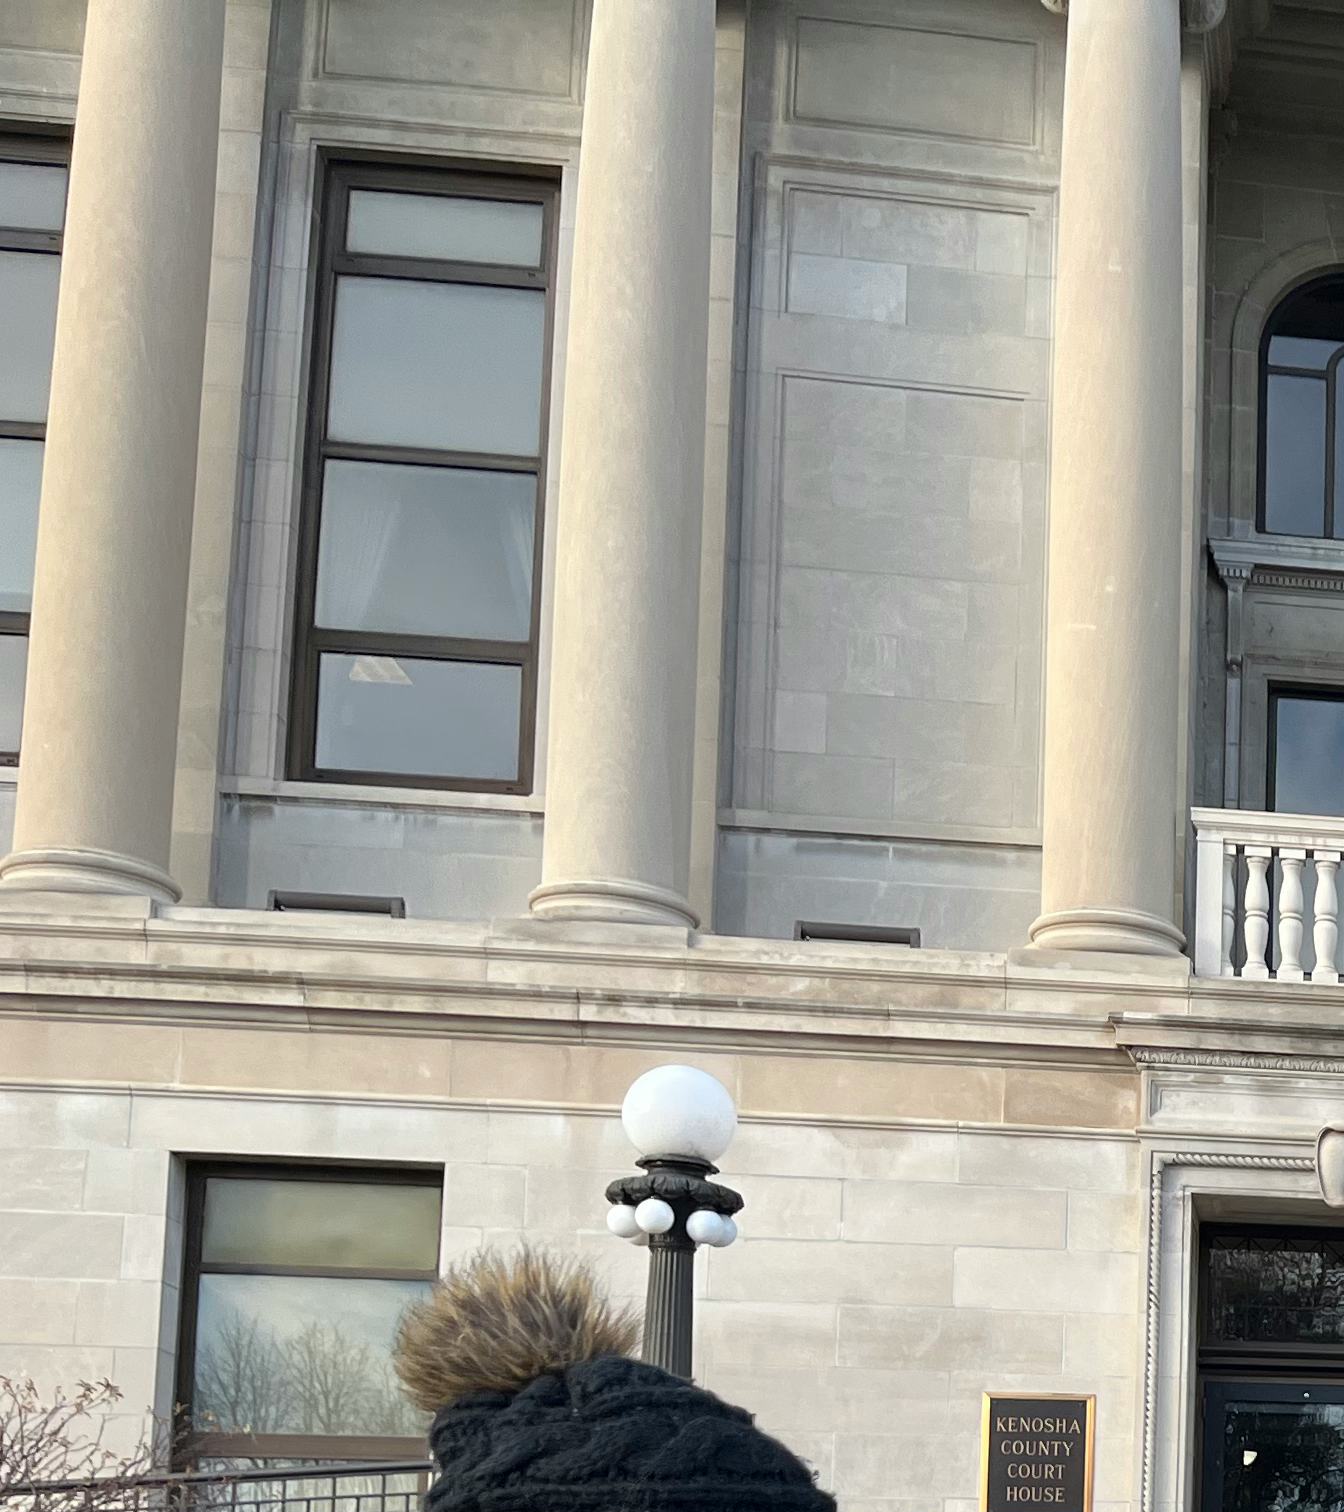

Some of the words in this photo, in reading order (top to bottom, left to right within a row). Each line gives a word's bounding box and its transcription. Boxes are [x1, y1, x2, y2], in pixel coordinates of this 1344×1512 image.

[996, 1416, 1081, 1434] KENOSHA
[1001, 1440, 1074, 1456] COUNTY
[1007, 1463, 1066, 1480] COURT
[1006, 1486, 1065, 1502] HOUSE
